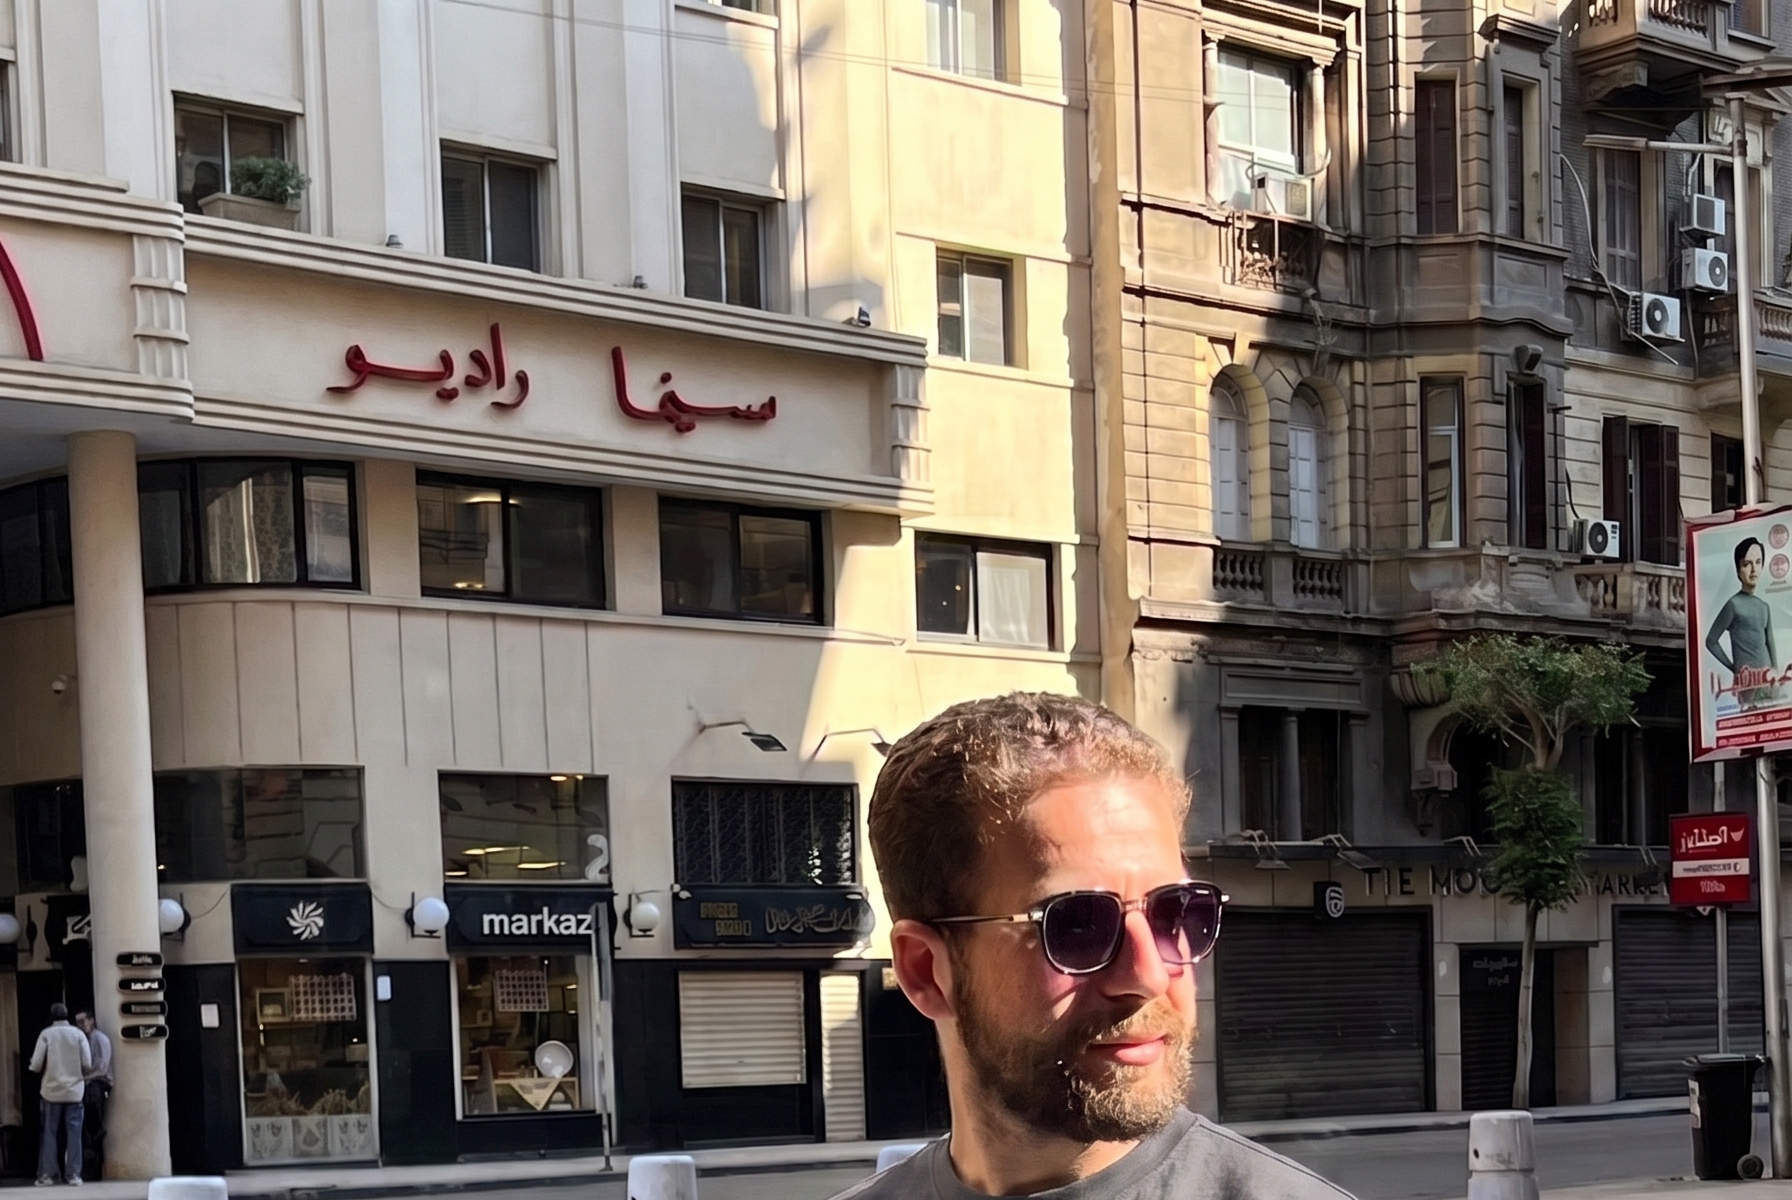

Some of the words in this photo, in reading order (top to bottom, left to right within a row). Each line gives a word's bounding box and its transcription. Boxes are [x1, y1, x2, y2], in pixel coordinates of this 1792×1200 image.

[326, 322, 529, 409] راديو
[611, 346, 777, 433] سينما
[482, 906, 593, 935] markaz
